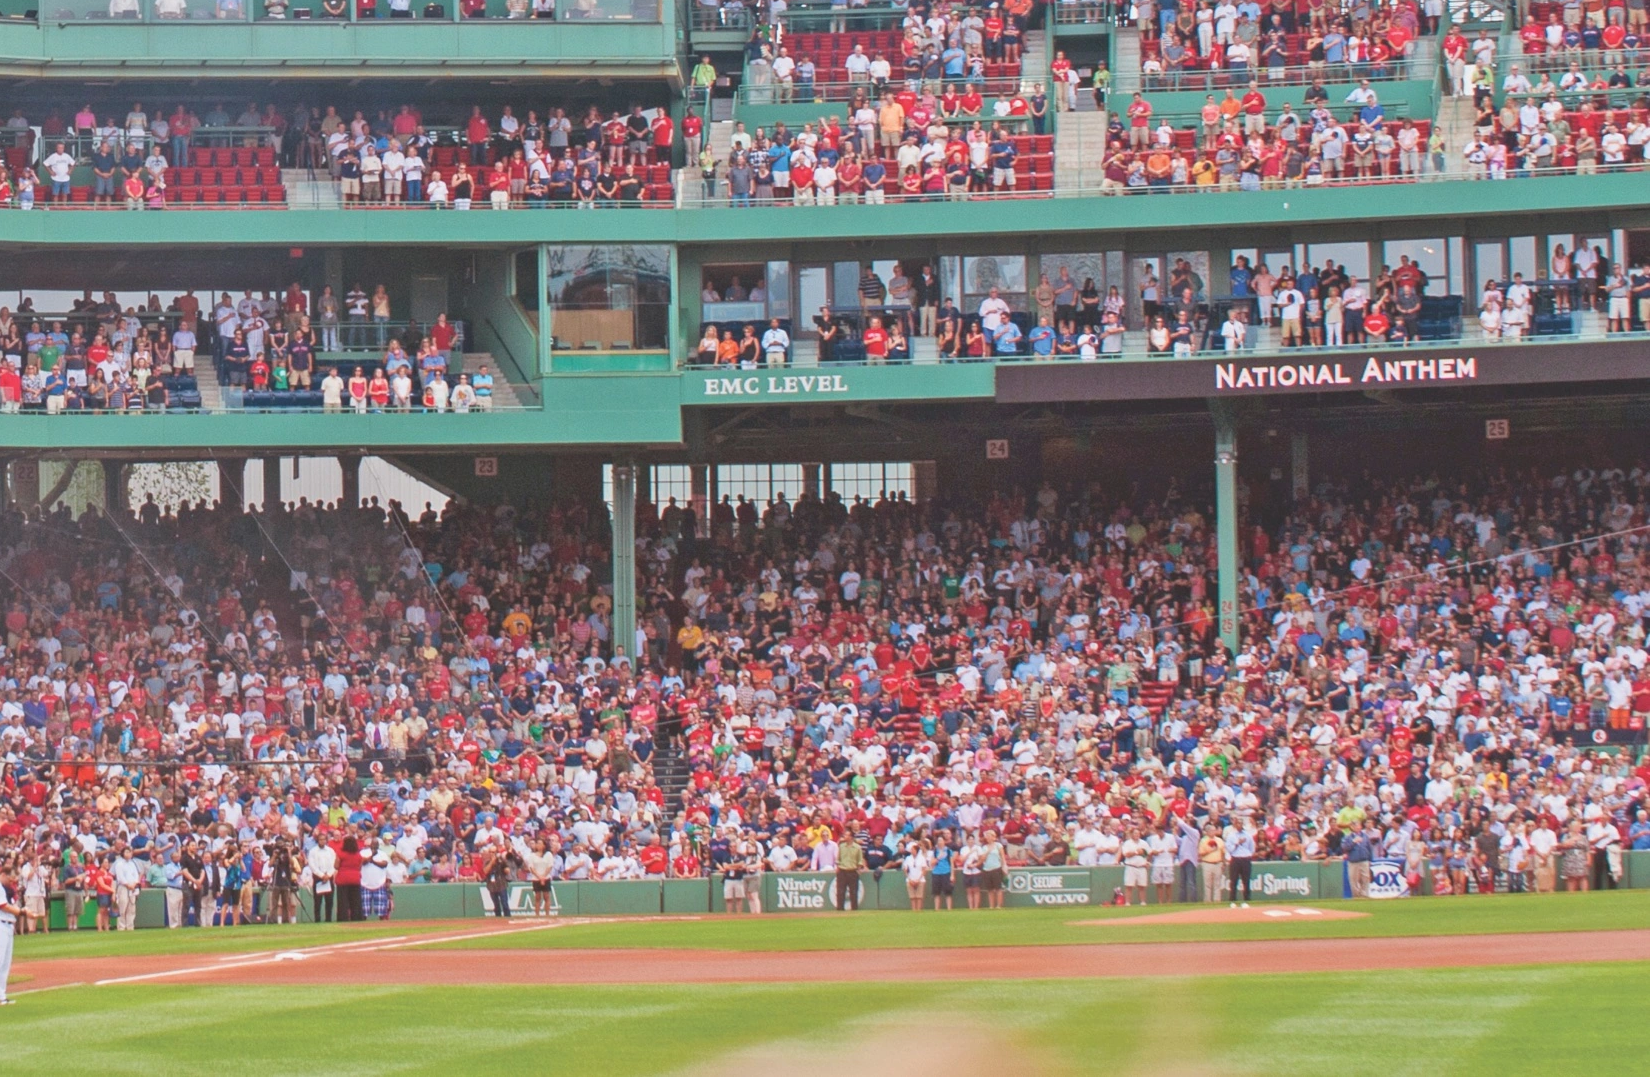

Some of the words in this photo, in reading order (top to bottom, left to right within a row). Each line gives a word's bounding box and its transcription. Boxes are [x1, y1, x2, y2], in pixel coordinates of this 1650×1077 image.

[1214, 361, 1351, 390] NATIONAL
[1360, 356, 1477, 383] ANTHEM
[703, 377, 760, 395] EMC
[766, 374, 848, 394] LEVEL
[1488, 421, 1505, 437] 25
[989, 442, 1006, 456] 24
[18, 465, 34, 481] 22
[478, 459, 494, 474] 23
[777, 877, 827, 894] Ninety
[1263, 872, 1310, 896] Spring
[1373, 870, 1401, 888] OX
[777, 890, 825, 908] Nine
[1031, 892, 1090, 904] VOLVO
